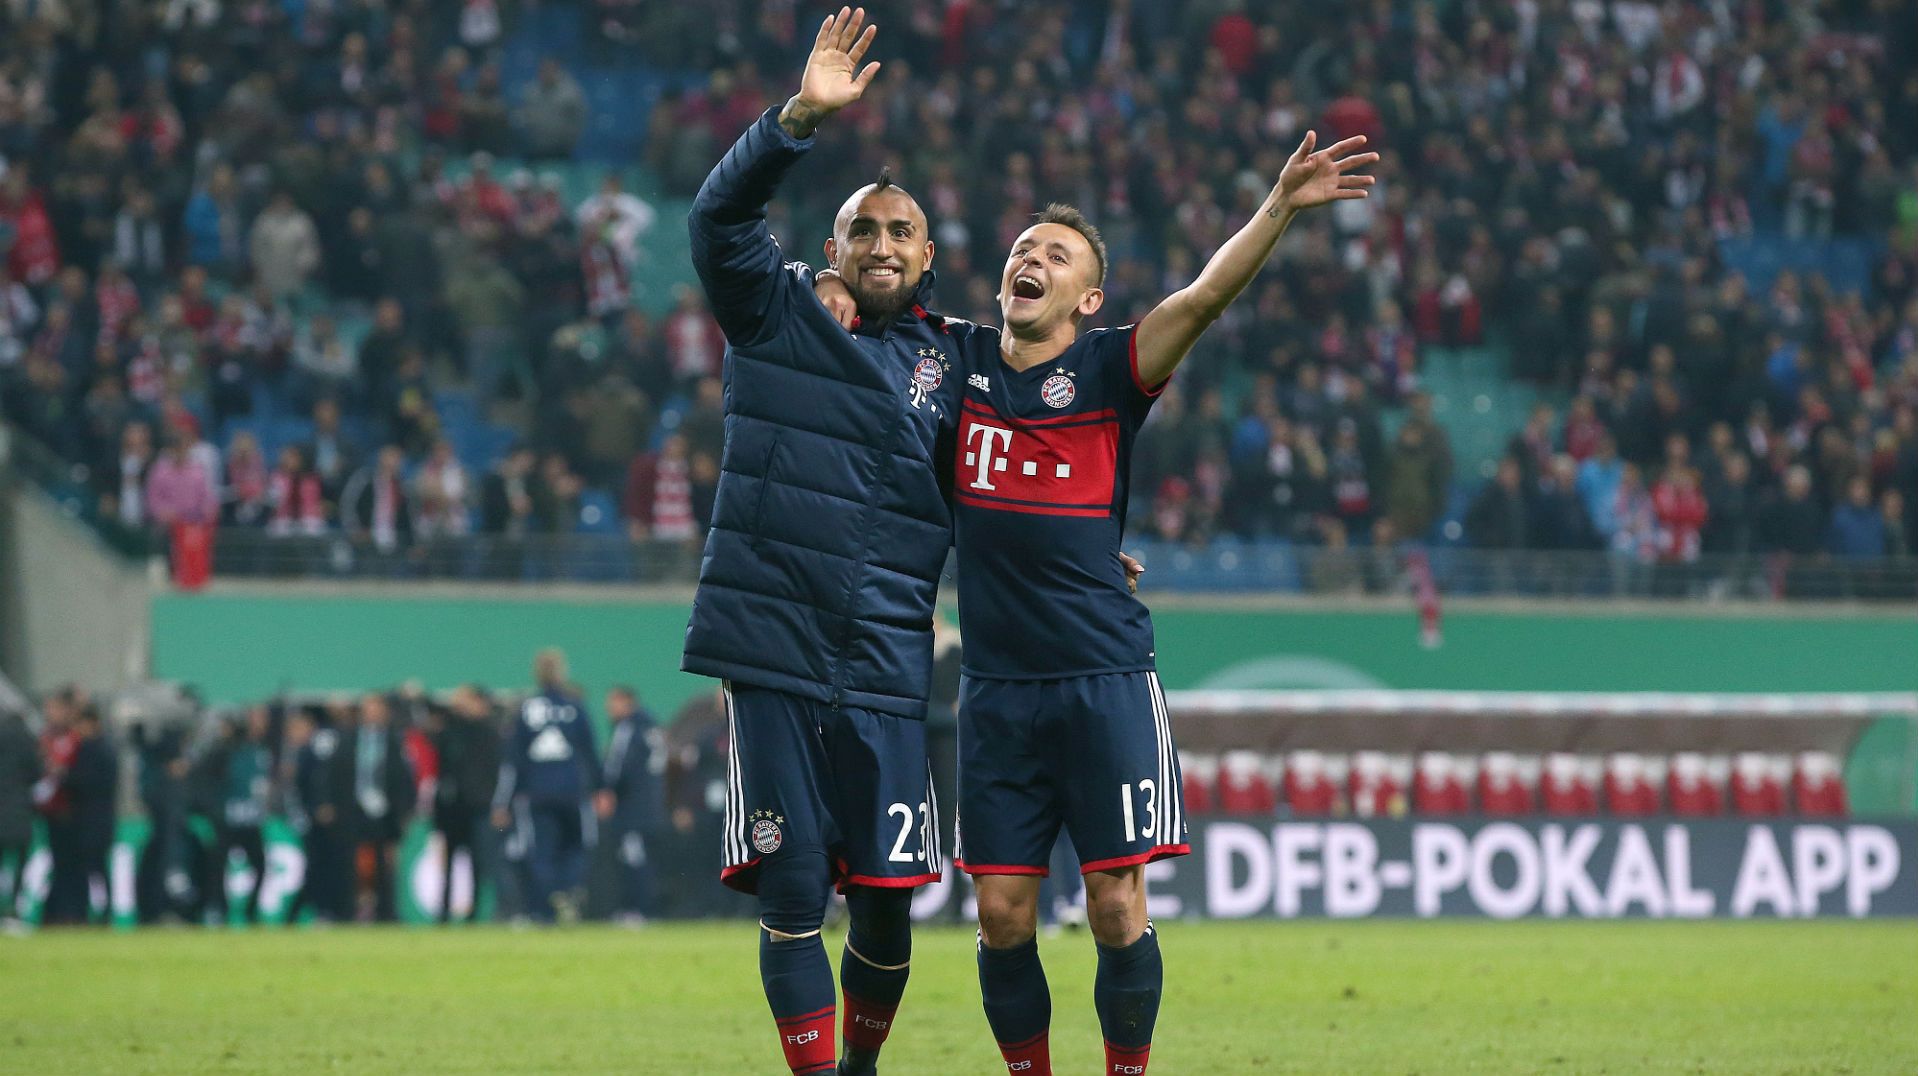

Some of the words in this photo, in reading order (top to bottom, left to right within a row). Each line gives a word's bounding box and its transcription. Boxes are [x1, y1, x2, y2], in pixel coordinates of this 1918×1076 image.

[1049, 376, 1072, 388] BAYERN
[1122, 783, 1156, 841] 13
[887, 802, 927, 862] 23
[1205, 822, 1716, 918] DFB-POKAL
[1730, 824, 1900, 918] APP
[855, 1014, 887, 1029] FCB
[787, 1030, 819, 1045] FCB
[1115, 1063, 1143, 1074] FCB
